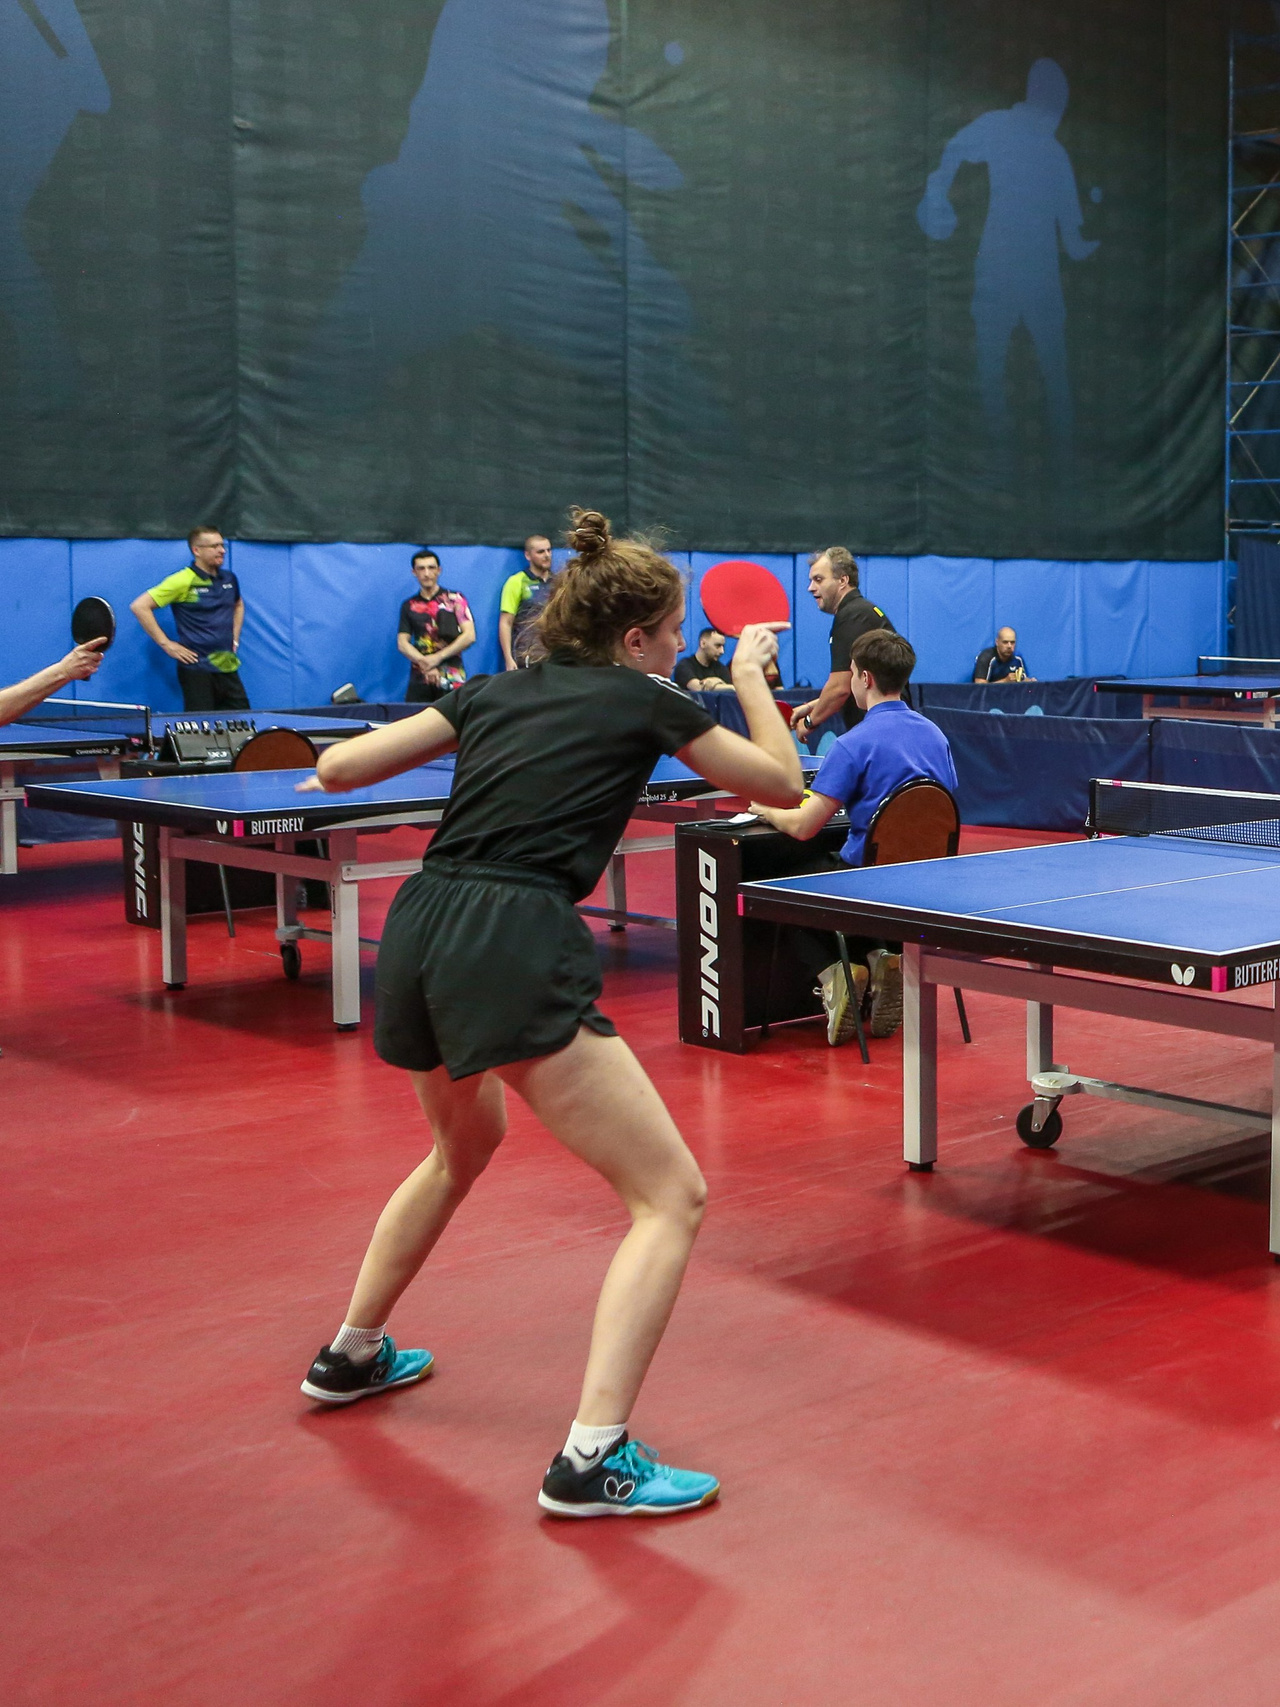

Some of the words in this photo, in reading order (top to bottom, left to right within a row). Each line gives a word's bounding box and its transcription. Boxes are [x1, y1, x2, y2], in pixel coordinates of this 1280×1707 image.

[132, 822, 148, 918] ONIC
[251, 817, 305, 835] BUTTERFLY
[698, 847, 721, 1039] DONIC
